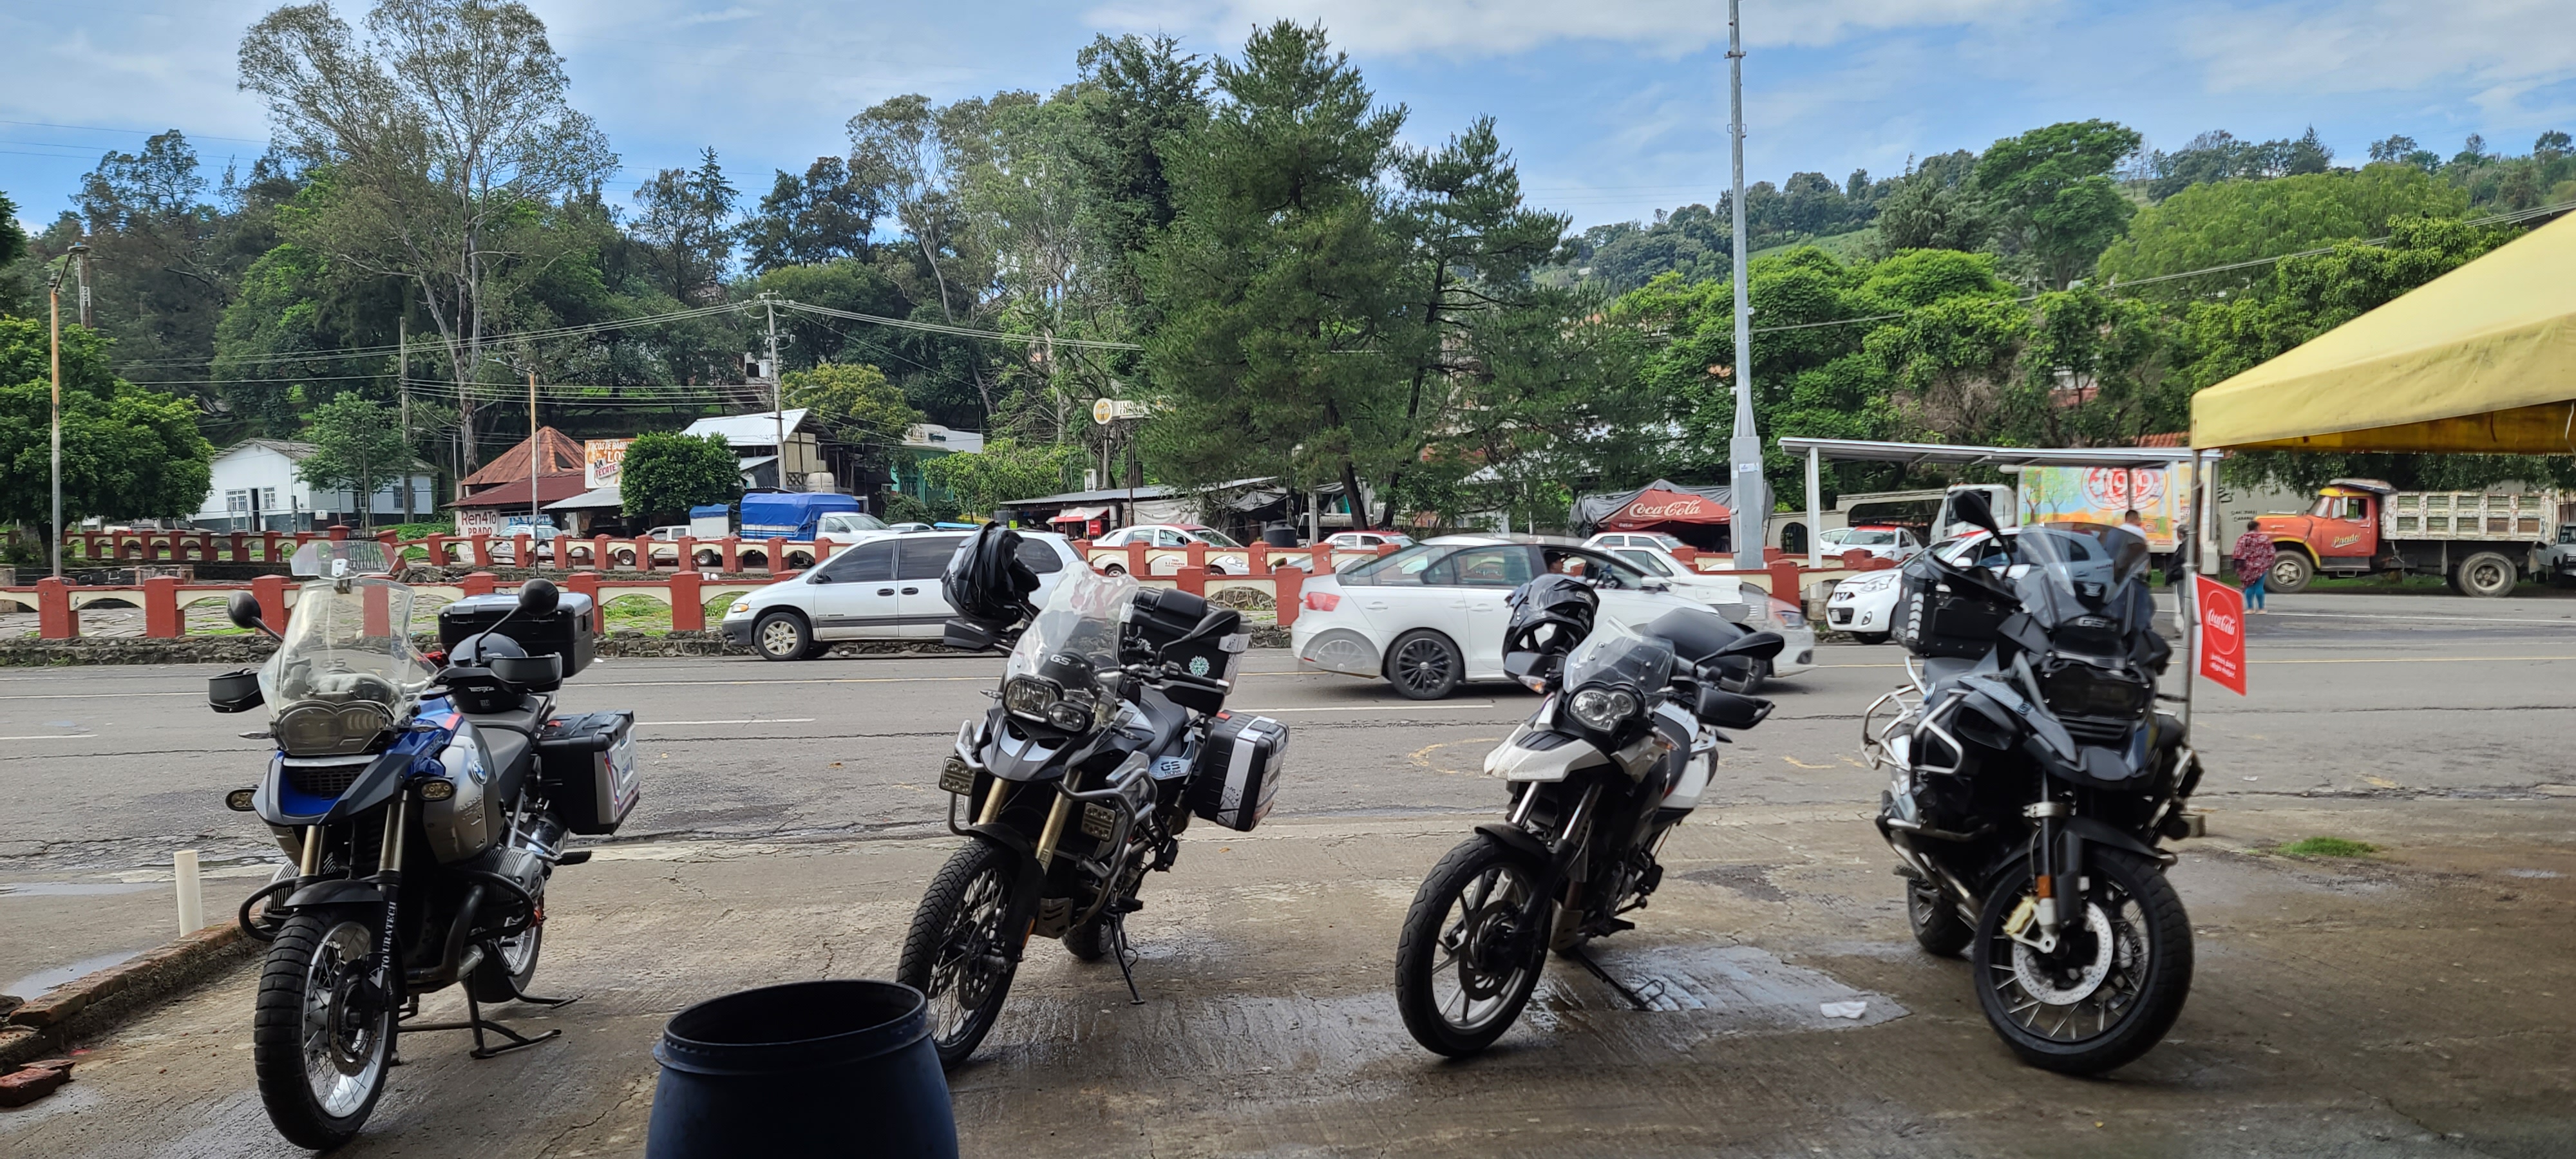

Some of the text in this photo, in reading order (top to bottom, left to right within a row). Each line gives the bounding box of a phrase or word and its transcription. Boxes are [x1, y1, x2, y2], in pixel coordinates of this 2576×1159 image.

[605, 441, 612, 450] DE
[595, 464, 617, 477] TECATE
[1629, 499, 1702, 518] Coca-Cola
[468, 527, 492, 536] PRADO
[2077, 616, 2107, 628] GS
[319, 658, 346, 668] GS
[1050, 654, 1071, 666] GS
[1160, 760, 1180, 771] GS
[381, 901, 396, 970] TOURATECH
